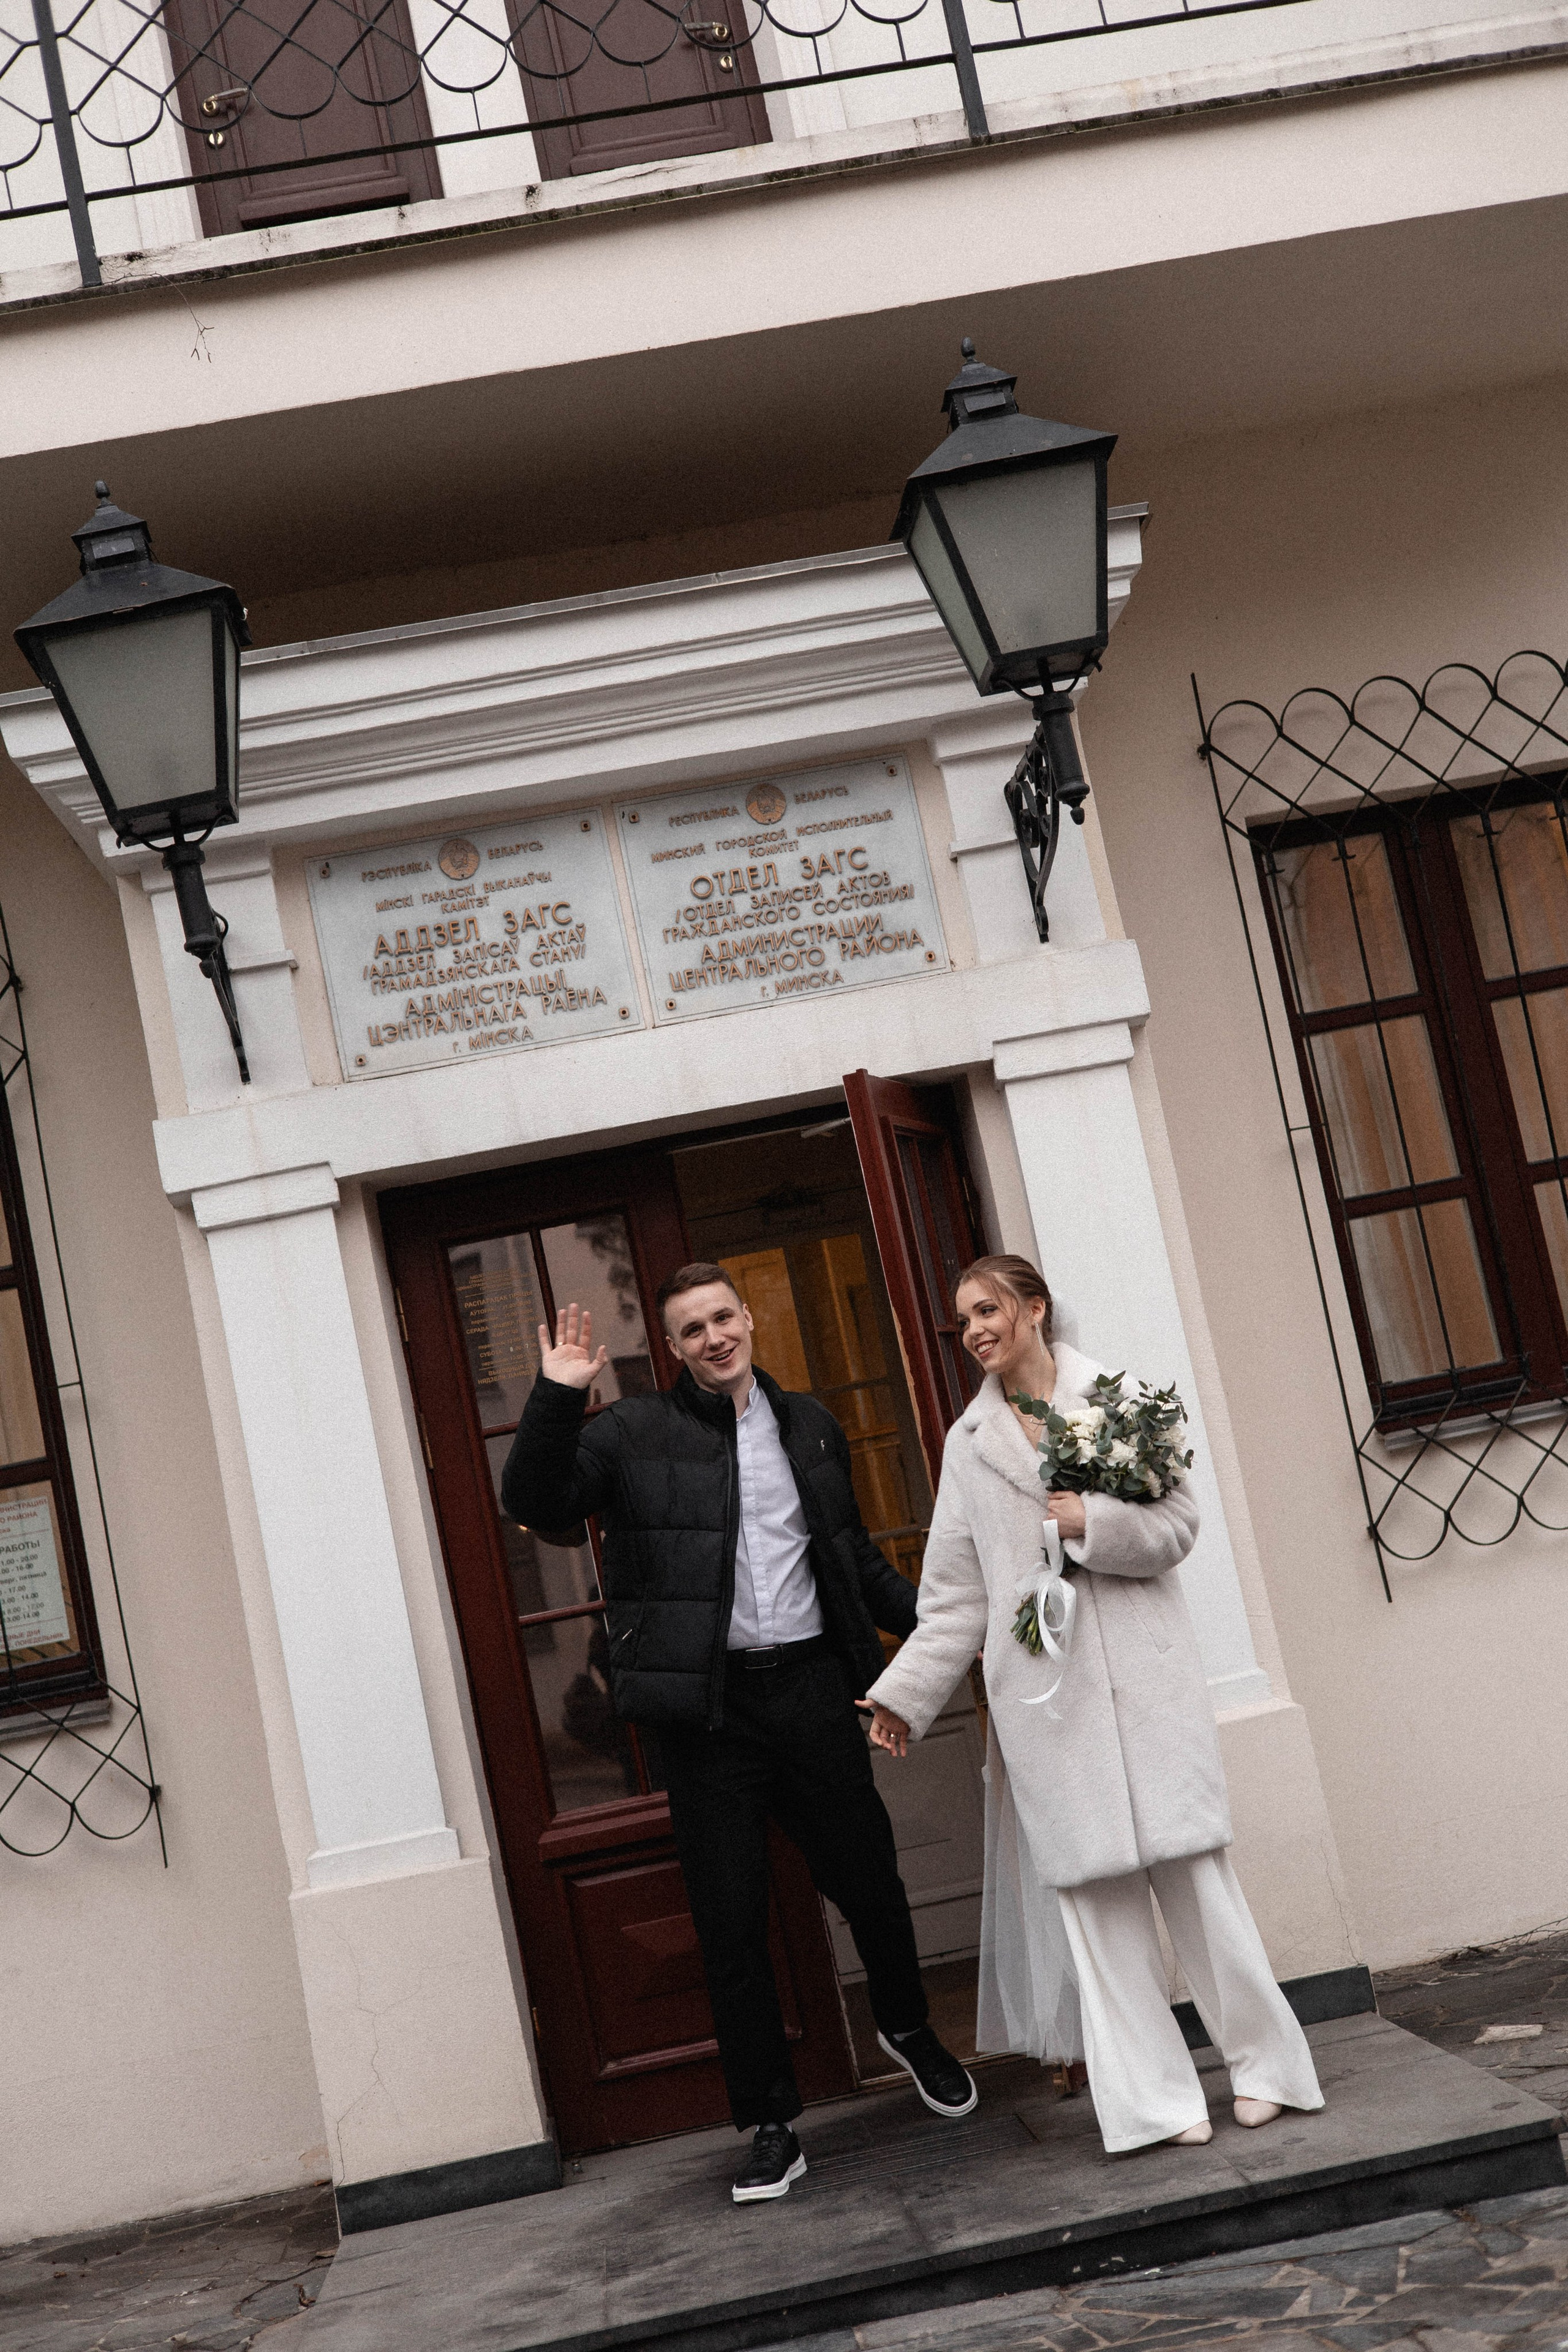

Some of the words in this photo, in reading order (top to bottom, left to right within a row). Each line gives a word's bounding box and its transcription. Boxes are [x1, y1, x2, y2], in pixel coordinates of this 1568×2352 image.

[669, 806, 740, 827] РЕСПУБЛИКА
[794, 785, 850, 804] БЕЛАРУСЬ
[651, 843, 706, 864] МИНСКИЙ
[715, 828, 788, 851] ГОРОДСКОЙ
[797, 809, 894, 837] ИСПОЛНИТЕЛЬНЫЙ
[748, 840, 800, 858] КОМИТЕТ
[361, 861, 432, 882] РЭСПУБЛІКА
[488, 840, 544, 859] БЕЛАРУСЬ
[690, 862, 778, 899] ОТДЕЛ
[800, 846, 869, 879] ЗАГС
[375, 895, 414, 912] МІНСКІ
[422, 884, 476, 904] ГАРАДСКІ
[483, 872, 552, 892] ВЫКАНАЎЧЫ
[441, 895, 489, 913] КАМІТЭТ
[750, 881, 823, 909] ЗАПИСЕЙ
[837, 870, 891, 894] АКТОВ
[374, 917, 480, 959] АДДЗЕЛ
[503, 901, 573, 933] ЗАГС
[453, 935, 521, 963] ЗАПІСАЎ
[537, 923, 586, 949] АКТАЎ
[663, 905, 800, 944] ГРАЖДАНСКОГО
[702, 913, 883, 963] АДМИНИСТРАЦИИ
[371, 957, 521, 995] ГРАМАДЗЯНСКАГА
[669, 947, 826, 992] ЦЕНТРАЛЬНОГО
[839, 929, 924, 960] РАЙОНА
[405, 968, 567, 1018] АДМІНІСТРАЦЫІ
[775, 970, 844, 995] МИНСКА
[368, 1000, 527, 1046] ЦЭНТРАЛЬНАГА
[541, 986, 607, 1016] РАЁНА
[469, 1026, 533, 1050] МІНСКА
[0, 1540, 40, 1555] РАБОТЫ
